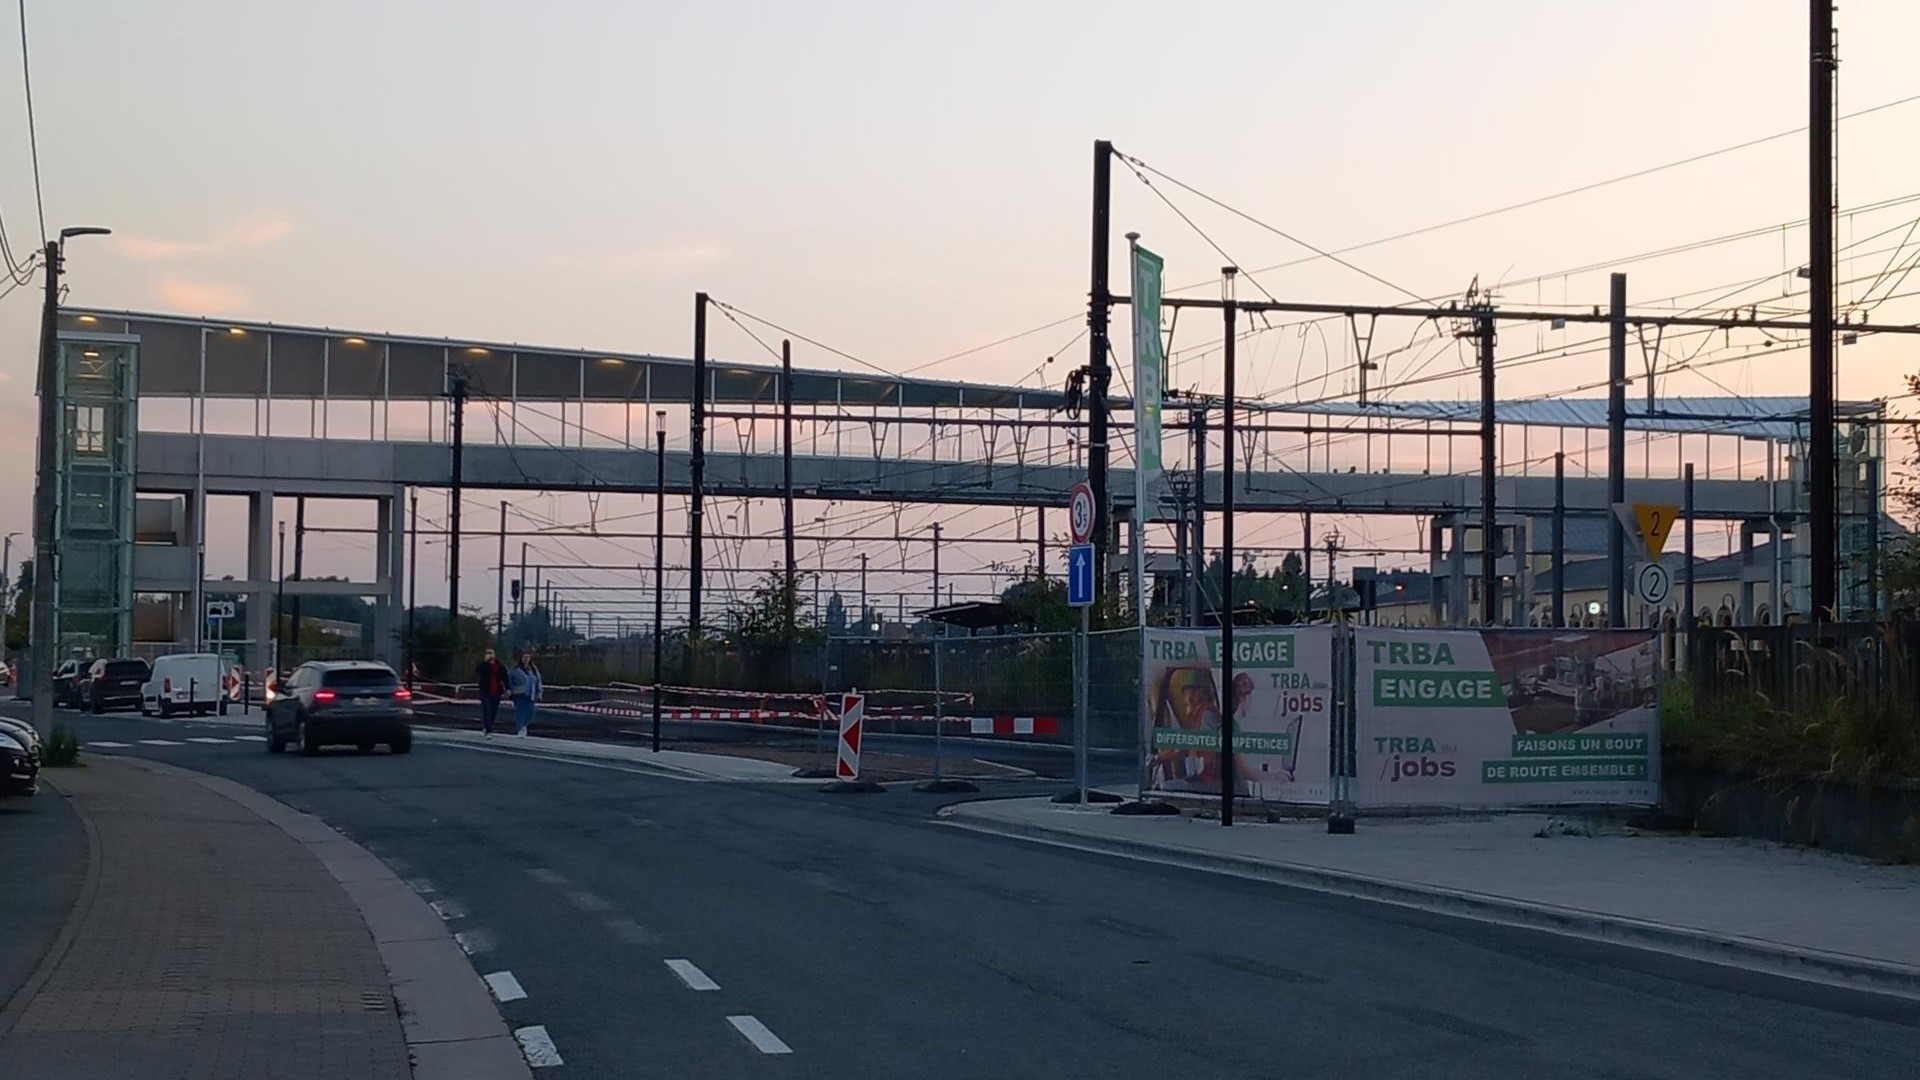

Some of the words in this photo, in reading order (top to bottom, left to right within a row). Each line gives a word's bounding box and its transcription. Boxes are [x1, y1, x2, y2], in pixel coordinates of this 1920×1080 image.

[1650, 511, 1660, 536] 2
[1649, 571, 1660, 598] 2
[1150, 639, 1199, 661] TRBA
[1367, 639, 1455, 665] TRBA
[1380, 678, 1492, 699] ENGAGE
[1517, 740, 1576, 752] FAISONS
[1580, 739, 1600, 751] UN
[1605, 739, 1643, 750] BOUT
[1487, 767, 1506, 778] DE
[1510, 766, 1557, 778] ROUTE
[1562, 765, 1636, 777] ENSEMBLE
